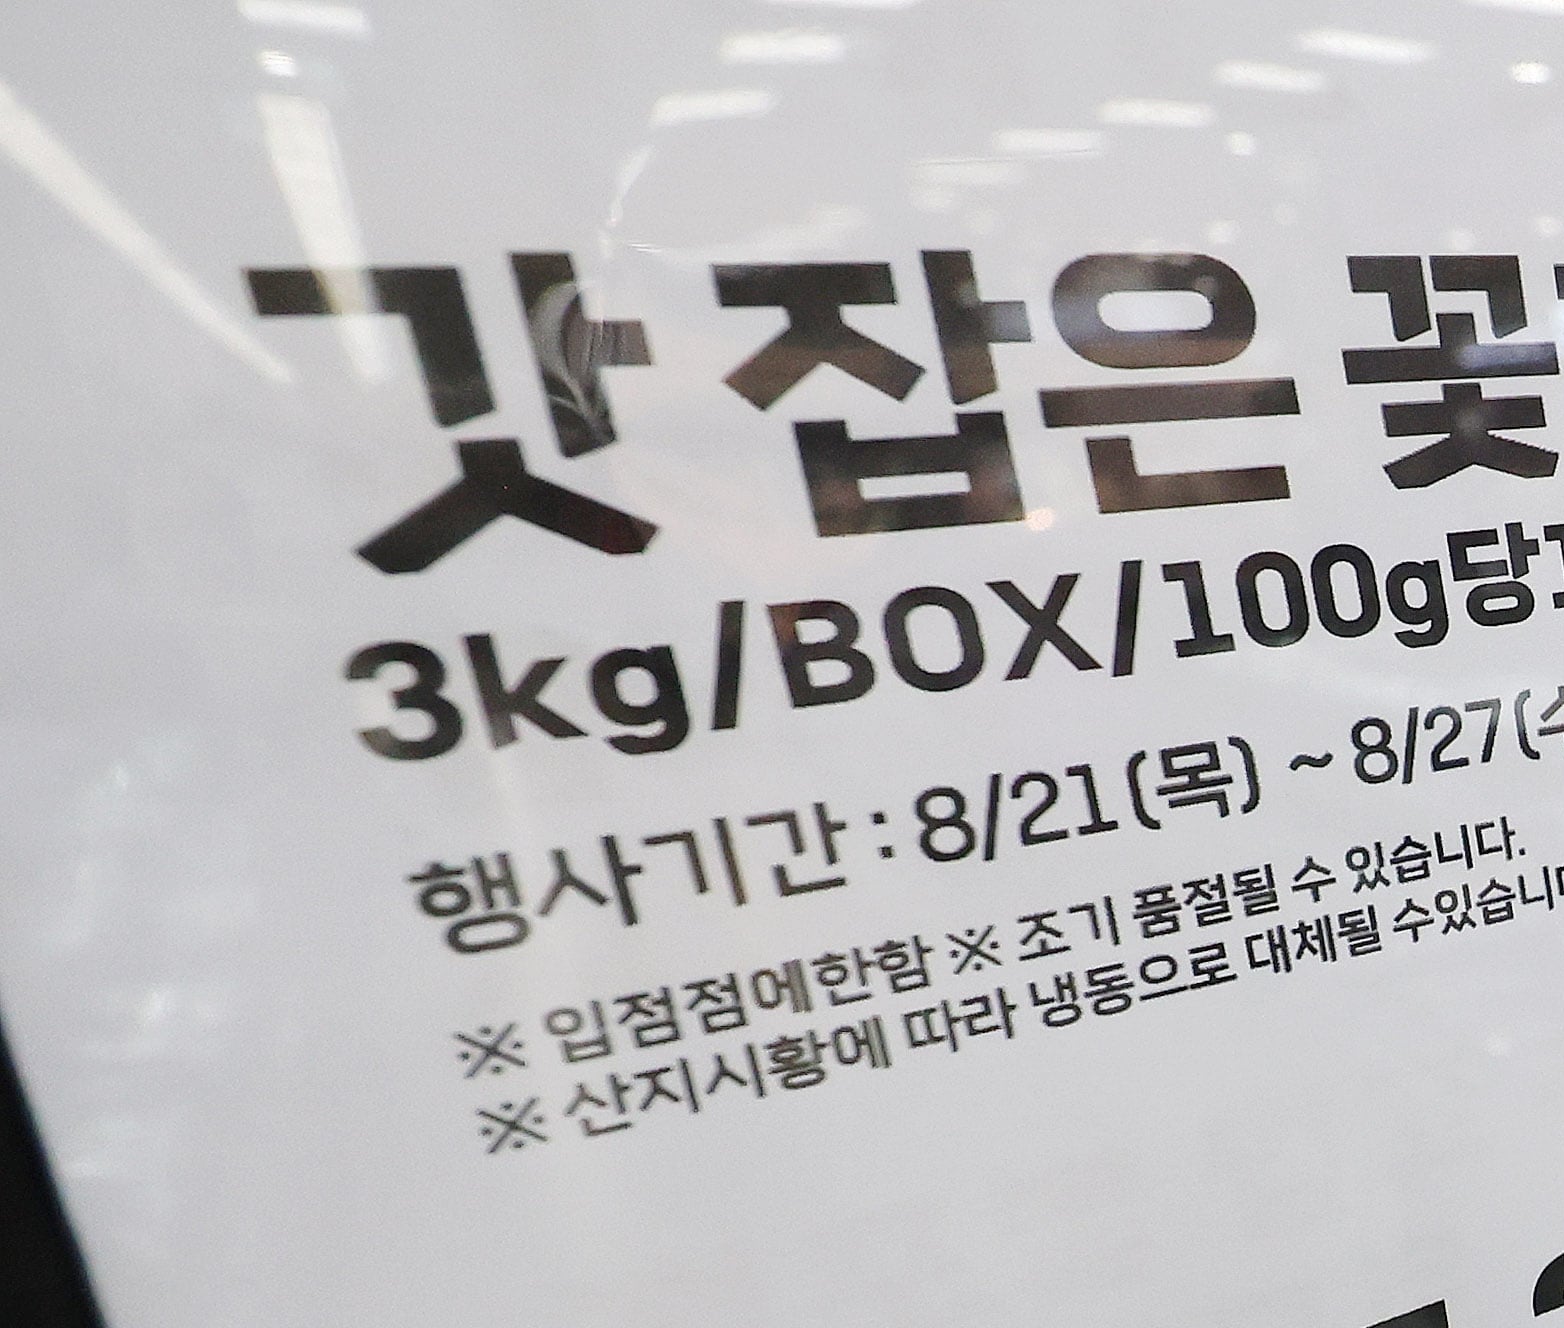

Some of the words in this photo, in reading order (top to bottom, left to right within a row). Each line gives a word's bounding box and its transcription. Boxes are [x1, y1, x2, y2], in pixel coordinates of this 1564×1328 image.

[240, 250, 660, 575] 갓
[709, 248, 1301, 538] 잡은
[408, 801, 848, 954] 행사기간
[913, 736, 1261, 863] 8/21(목)
[544, 935, 934, 1064] 입점점에한함
[1017, 901, 1121, 964] 조기
[1132, 862, 1281, 940] 품절될
[1291, 856, 1338, 903] 수
[1345, 817, 1526, 895] 있습니다.
[562, 1016, 892, 1138] 산지시황에
[902, 988, 1018, 1053] 따라
[1030, 945, 1239, 1028] 냉동으로
[1245, 905, 1382, 975] 대체될
